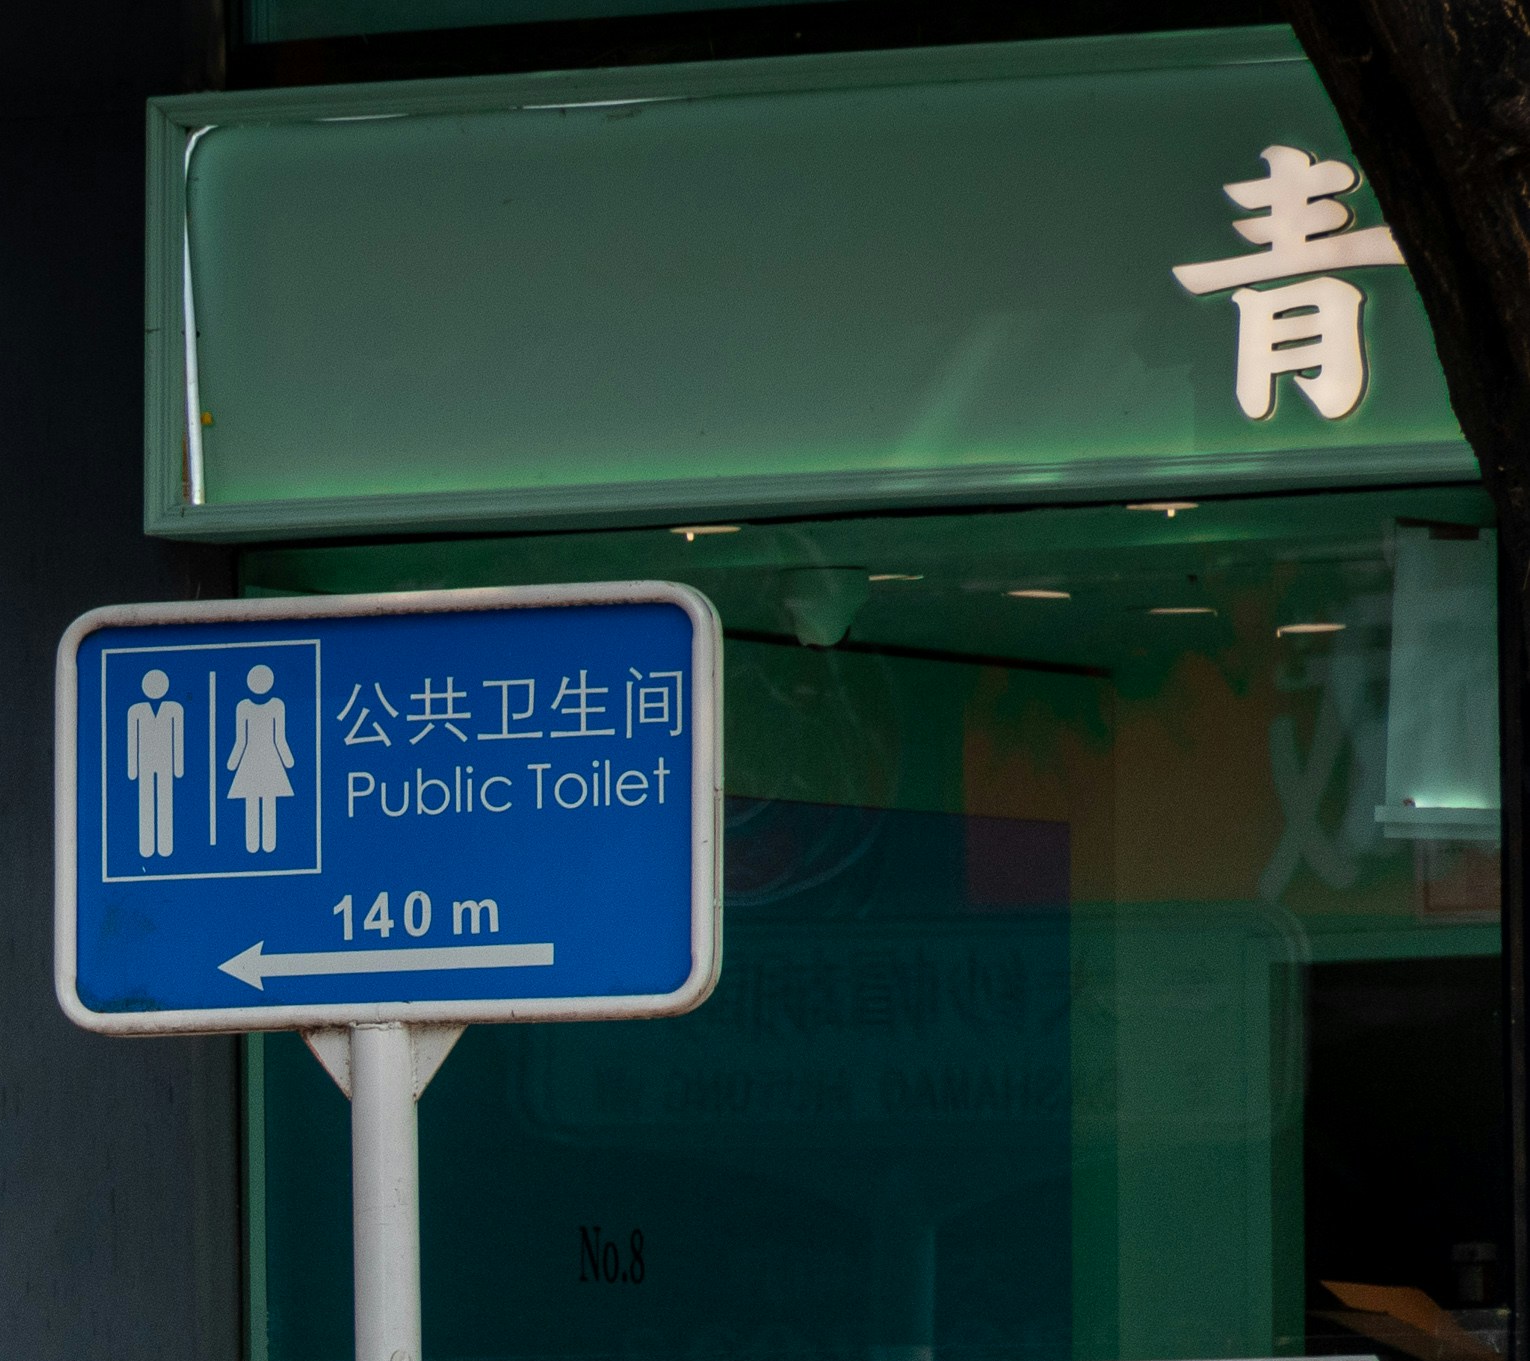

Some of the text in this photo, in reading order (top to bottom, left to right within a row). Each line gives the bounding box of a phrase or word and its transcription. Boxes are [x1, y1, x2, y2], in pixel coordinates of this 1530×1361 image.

[1171, 145, 1407, 421] 青
[336, 667, 685, 749] 公共卫生间
[347, 757, 671, 818] Public Toilet
[332, 890, 499, 941] 140 m
[578, 1226, 646, 1285] No.8
